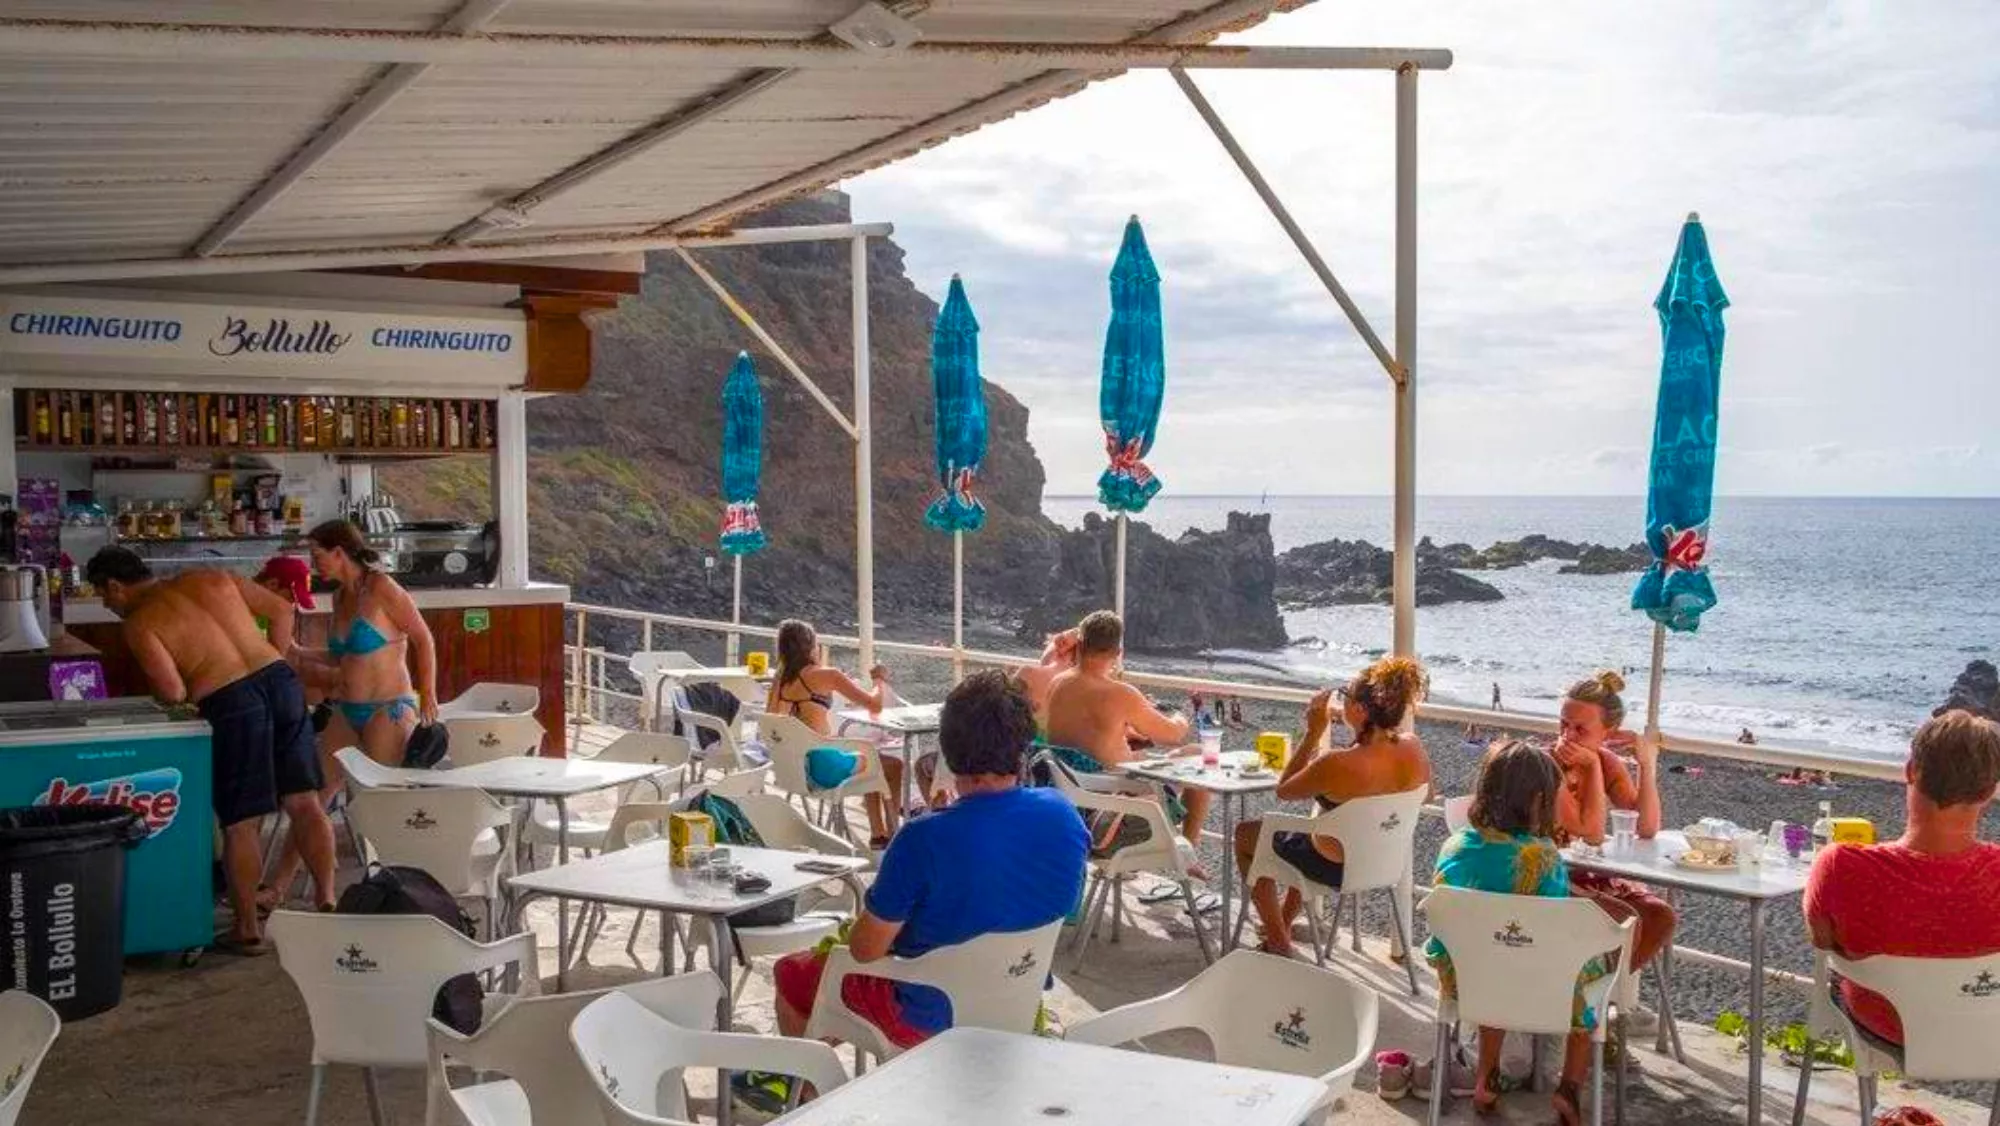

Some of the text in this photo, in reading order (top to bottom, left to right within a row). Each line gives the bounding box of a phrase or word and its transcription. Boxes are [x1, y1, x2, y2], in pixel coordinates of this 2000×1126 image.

[10, 313, 512, 356] CHIRINGUITO Bollullo CHIRINGUITO
[50, 780, 178, 818] Klise
[47, 883, 76, 970] Bollullo
